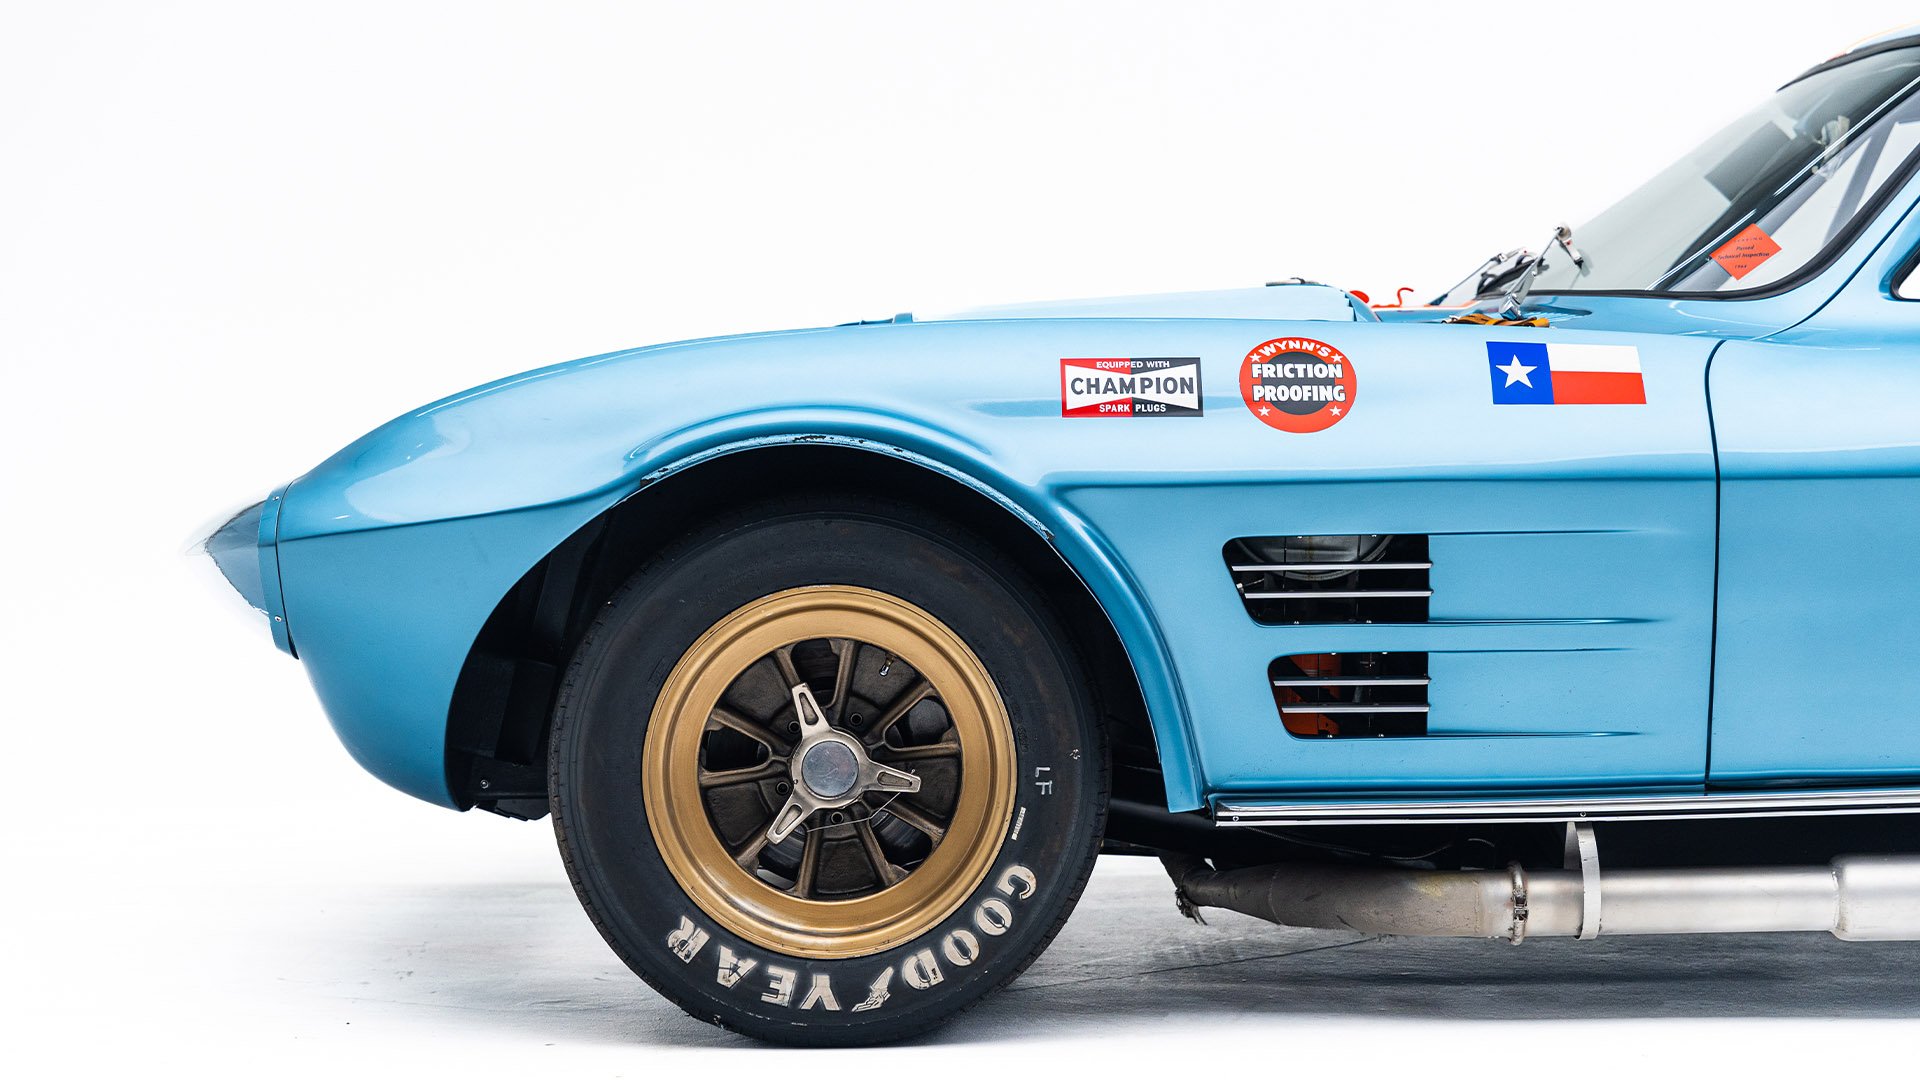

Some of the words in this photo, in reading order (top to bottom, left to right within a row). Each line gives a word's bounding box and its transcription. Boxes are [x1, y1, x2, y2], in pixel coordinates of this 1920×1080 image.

[1258, 340, 1332, 357] WYNN'S
[1096, 361, 1144, 369] EQUIPPED
[1252, 363, 1343, 379] FRICTION
[1070, 377, 1194, 394] CHAMPION
[1253, 385, 1346, 402] PROOFING
[1099, 404, 1131, 413] SPARK
[1135, 404, 1167, 413] PLUGS
